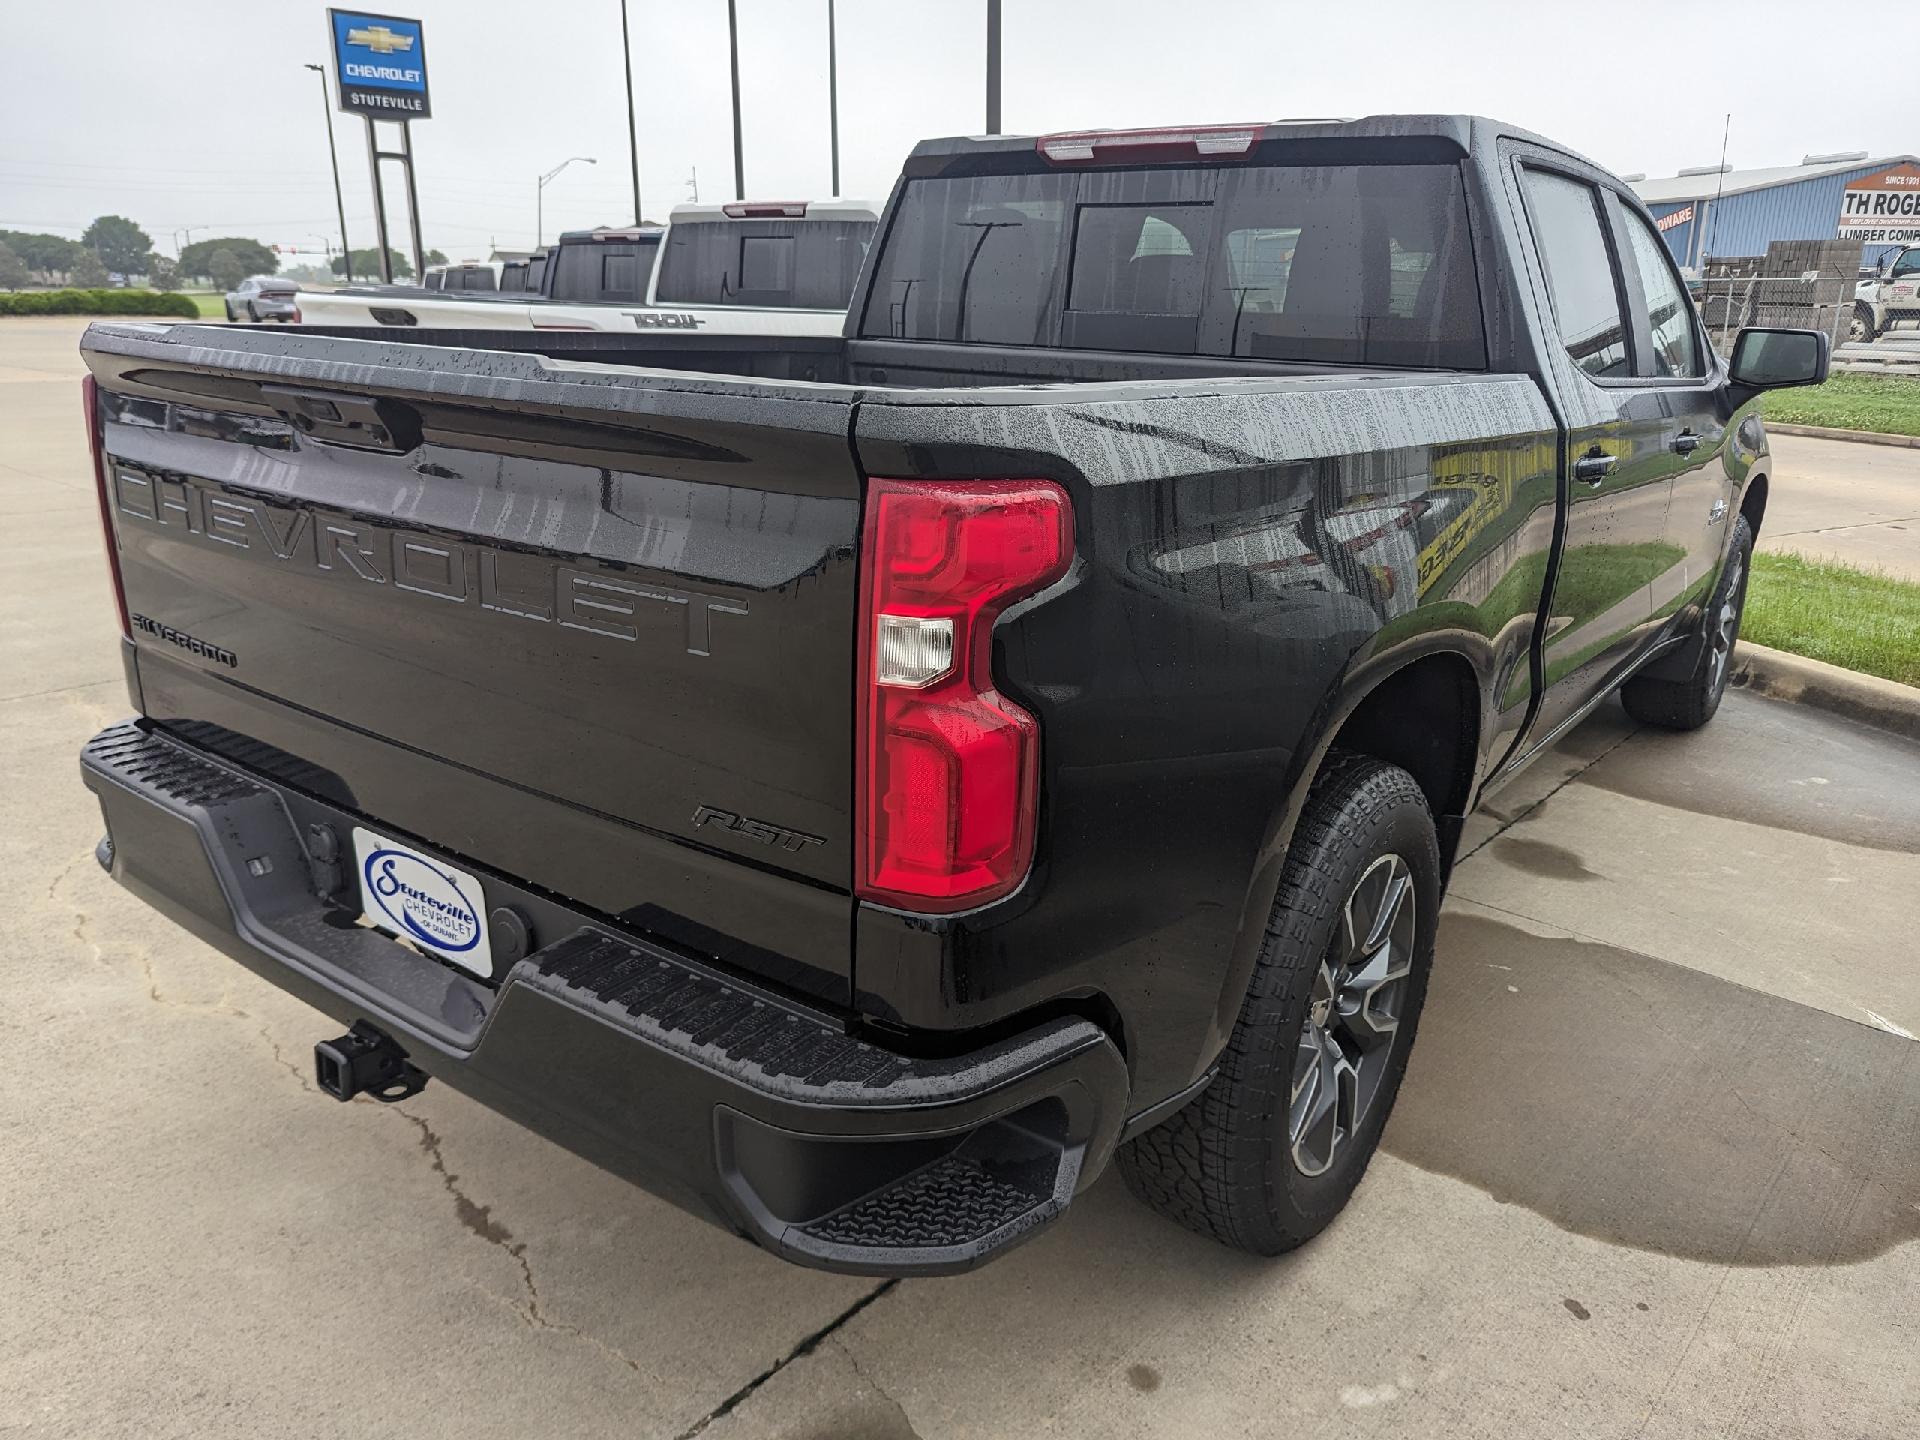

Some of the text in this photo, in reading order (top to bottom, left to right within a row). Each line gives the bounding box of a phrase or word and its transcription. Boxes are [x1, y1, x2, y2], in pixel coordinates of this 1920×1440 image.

[345, 63, 421, 83] CHEVROLET
[351, 92, 423, 111] STUTEVILLE
[1885, 175, 1905, 185] SINCE
[1845, 193, 1871, 215] TH
[1838, 229, 1886, 241] LUMBER
[113, 463, 750, 657] CHEVROLET
[132, 612, 238, 669] SILVERADO
[692, 803, 828, 853] RST
[376, 859, 475, 925] Stuteville
[404, 898, 472, 938] CHEVROLET
